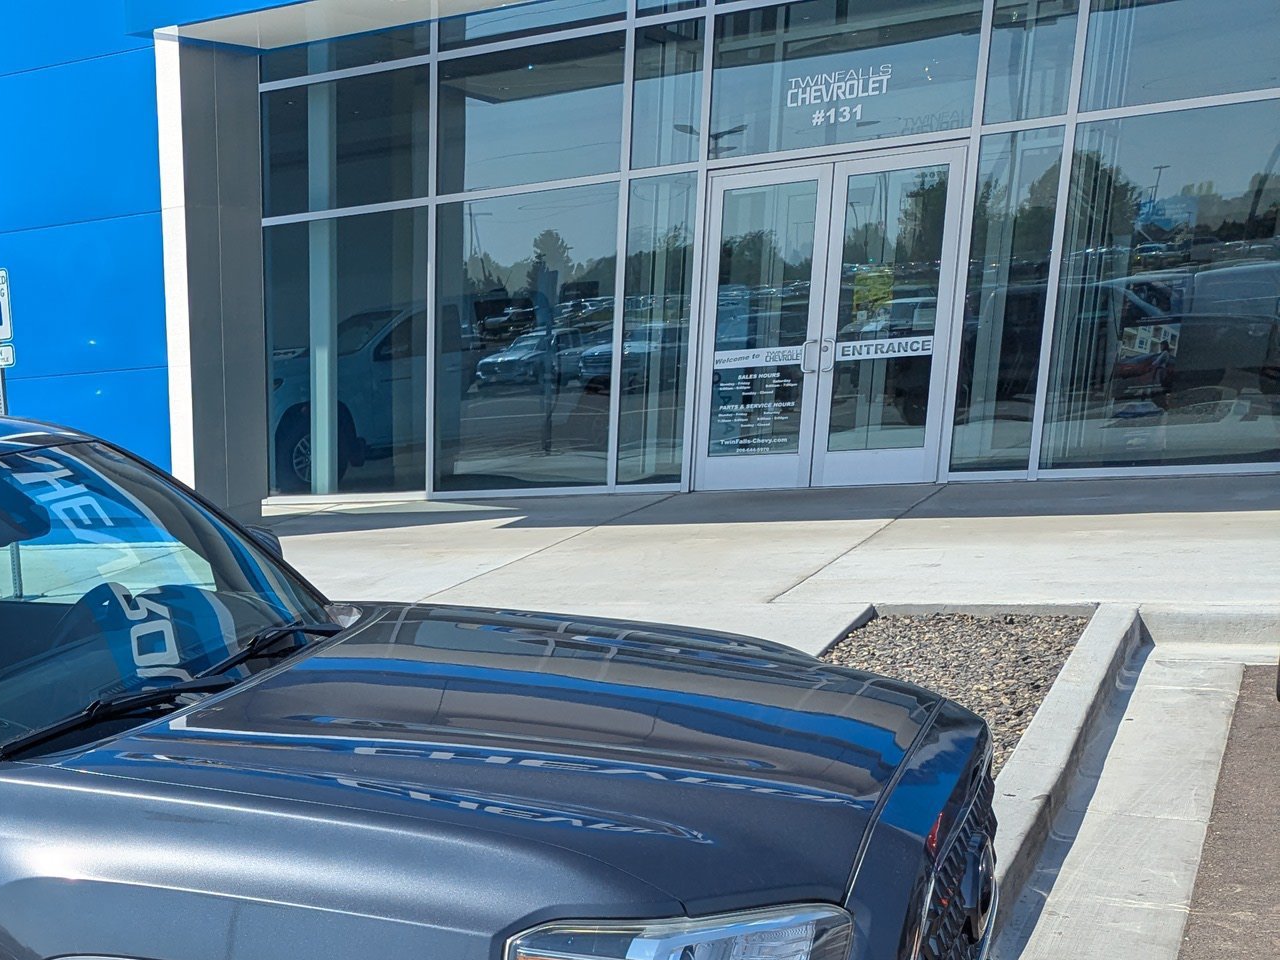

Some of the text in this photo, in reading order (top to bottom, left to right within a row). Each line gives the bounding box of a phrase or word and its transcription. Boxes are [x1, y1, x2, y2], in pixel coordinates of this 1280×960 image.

[788, 64, 892, 89] TWINFALLS
[787, 75, 891, 108] CHEVROLET
[811, 104, 862, 126] #131
[765, 353, 802, 362] CHEVROLE
[841, 339, 932, 357] ENTRANCE
[715, 355, 750, 365] Welcome
